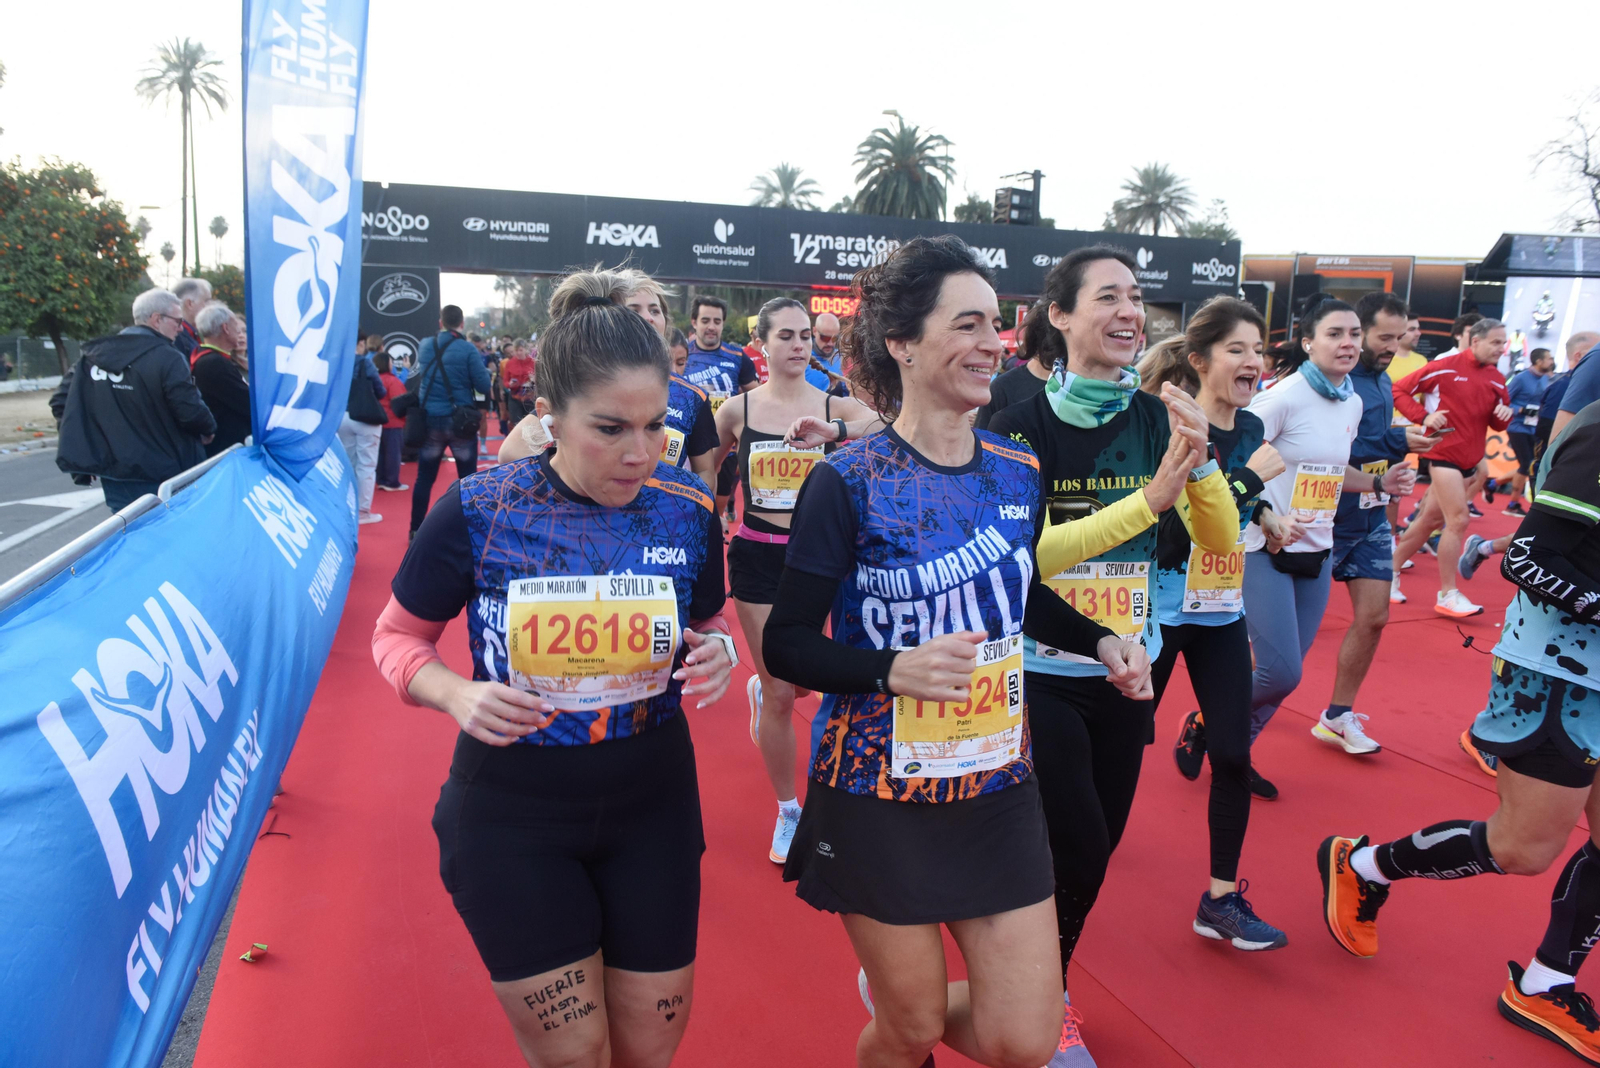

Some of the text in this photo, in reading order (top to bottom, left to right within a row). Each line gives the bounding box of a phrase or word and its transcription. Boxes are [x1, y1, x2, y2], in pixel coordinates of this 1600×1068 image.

[271, 9, 298, 84] FLY
[300, 0, 326, 91] HUM
[329, 29, 357, 99] FLY
[490, 220, 549, 233] HYUNDAI
[586, 222, 659, 248] HOKA
[815, 235, 900, 254] maratón
[266, 105, 355, 435] HOKA
[697, 258, 750, 267] Healthcare Partner
[836, 252, 888, 267] sevill
[825, 271, 836, 279] 28
[666, 407, 682, 420] OKA
[756, 457, 814, 478] 11027
[1053, 474, 1153, 492] LOS BALILLAS
[1301, 479, 1338, 499] 11090
[243, 474, 318, 570] HOKA
[643, 546, 687, 566] HOKA
[856, 525, 1012, 601] MEDIO MARATÓN
[1201, 551, 1243, 576] 9600
[1105, 563, 1135, 576] SEVILLA
[520, 578, 655, 598] MEDIO MARATÓN SEVILLA
[1054, 587, 1131, 617] 1319
[478, 593, 507, 635] MED
[522, 612, 650, 655] 12618
[567, 656, 606, 664] Macarena
[983, 638, 1011, 661] SEVILLA
[578, 696, 602, 704] HOKA
[37, 580, 238, 900] HOKA
[957, 760, 977, 769] HOKA
[126, 709, 264, 1015] FLY HUMAN FLY
[1336, 842, 1349, 874] HOKA
[523, 969, 586, 1010] FUERTE
[537, 995, 580, 1020] HASTA
[656, 994, 684, 1011] PAPA
[543, 1020, 560, 1031] EL
